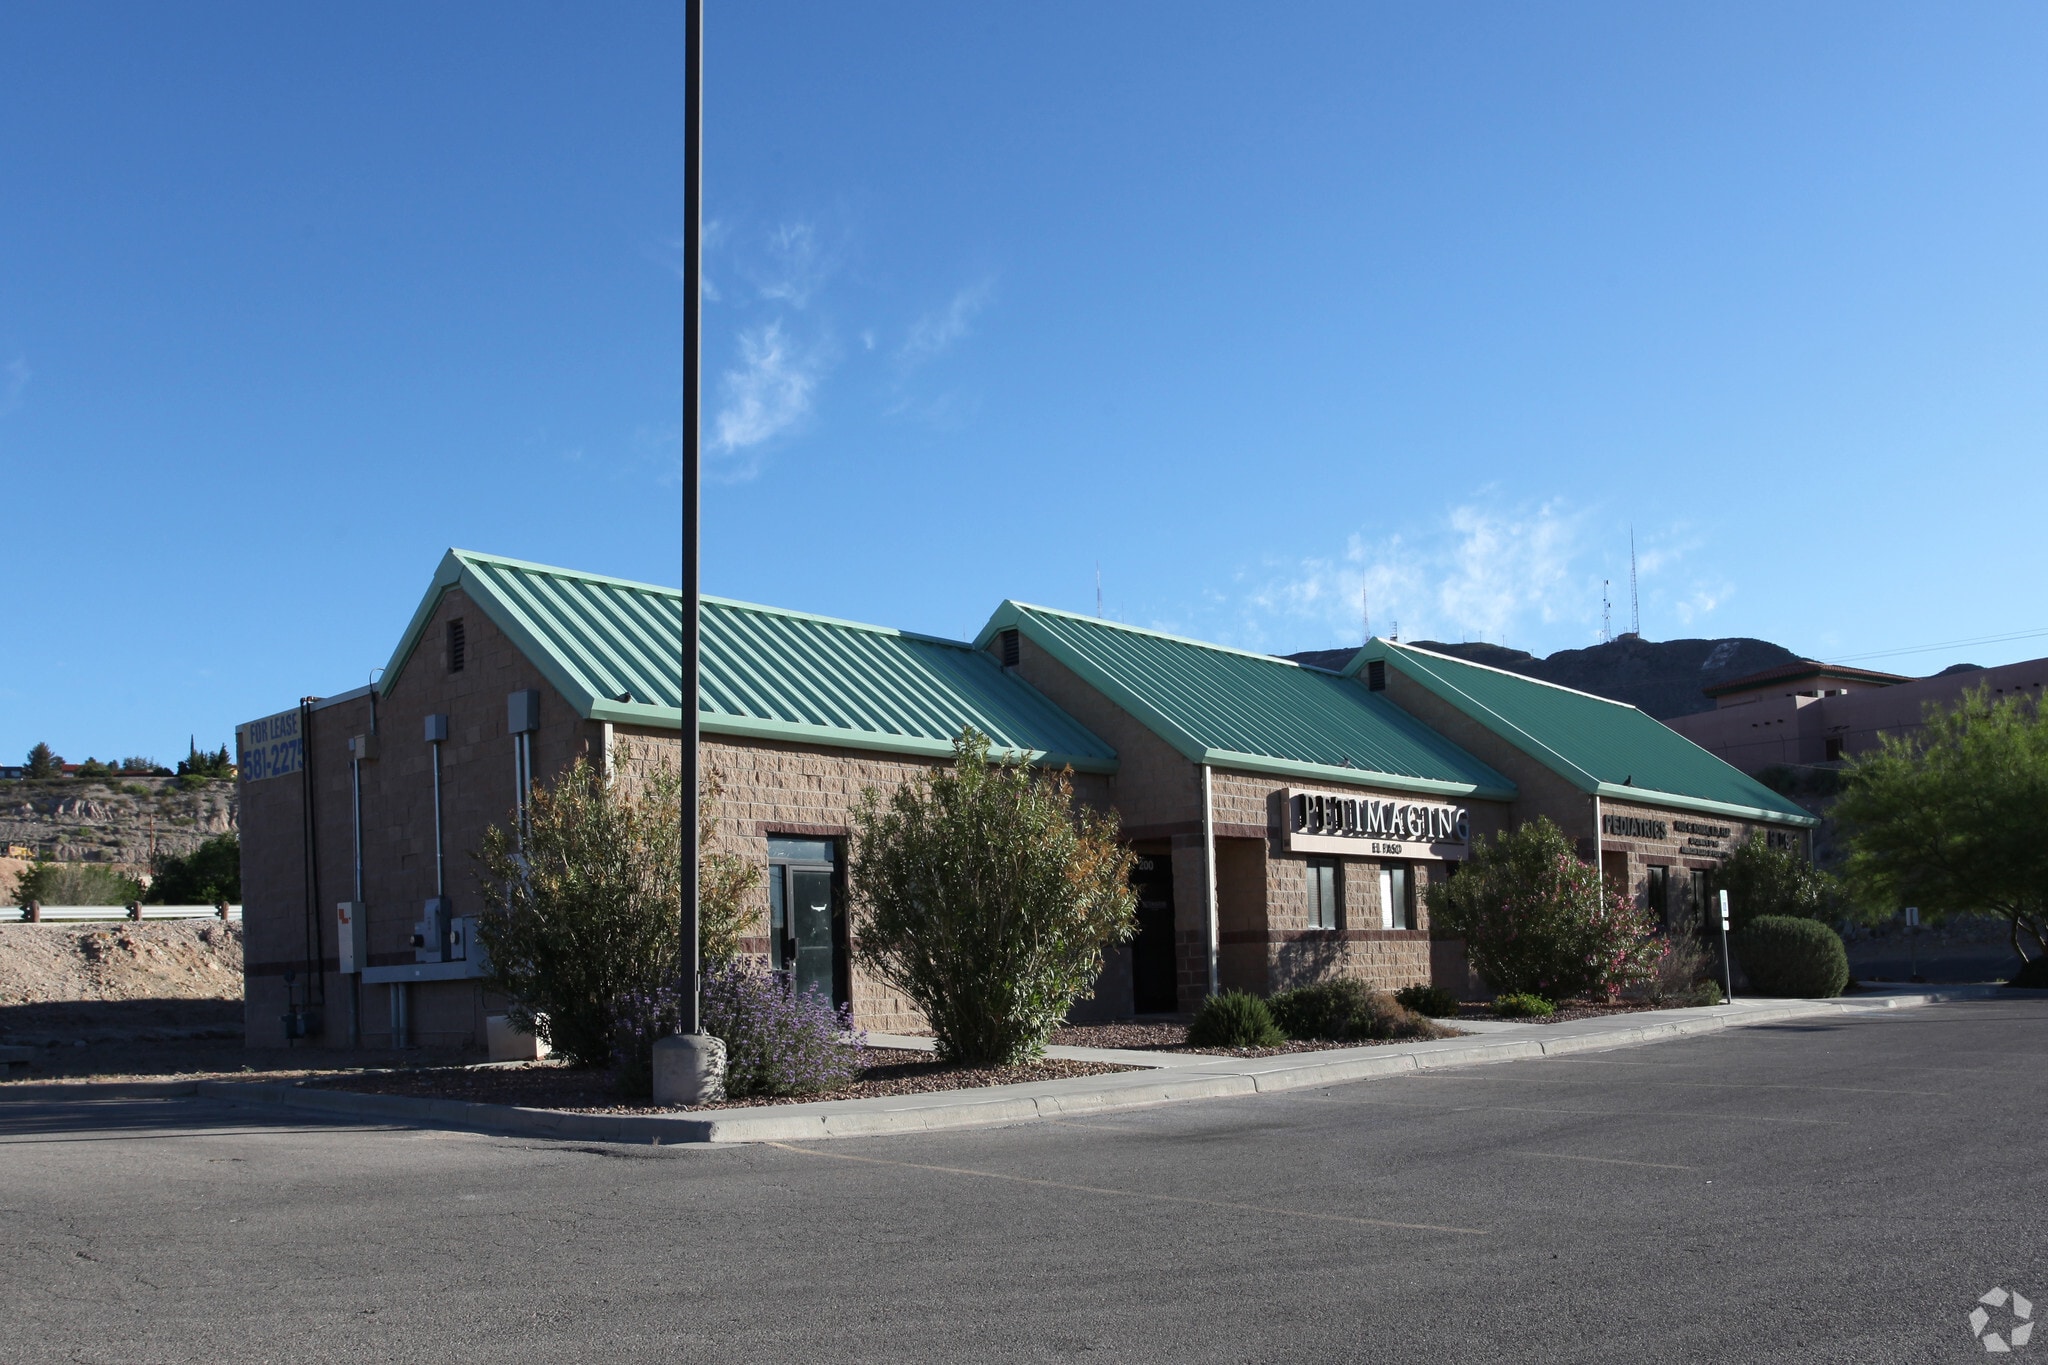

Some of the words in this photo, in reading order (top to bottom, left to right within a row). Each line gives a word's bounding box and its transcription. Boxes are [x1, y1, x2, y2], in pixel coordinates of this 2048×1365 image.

[250, 721, 268, 745] FOR
[270, 712, 298, 740] LEASE
[1603, 814, 1668, 840] PEDIATRICS
[1371, 842, 1381, 854] EL
[1382, 843, 1403, 855] PASO
[1138, 860, 1154, 871] 200
